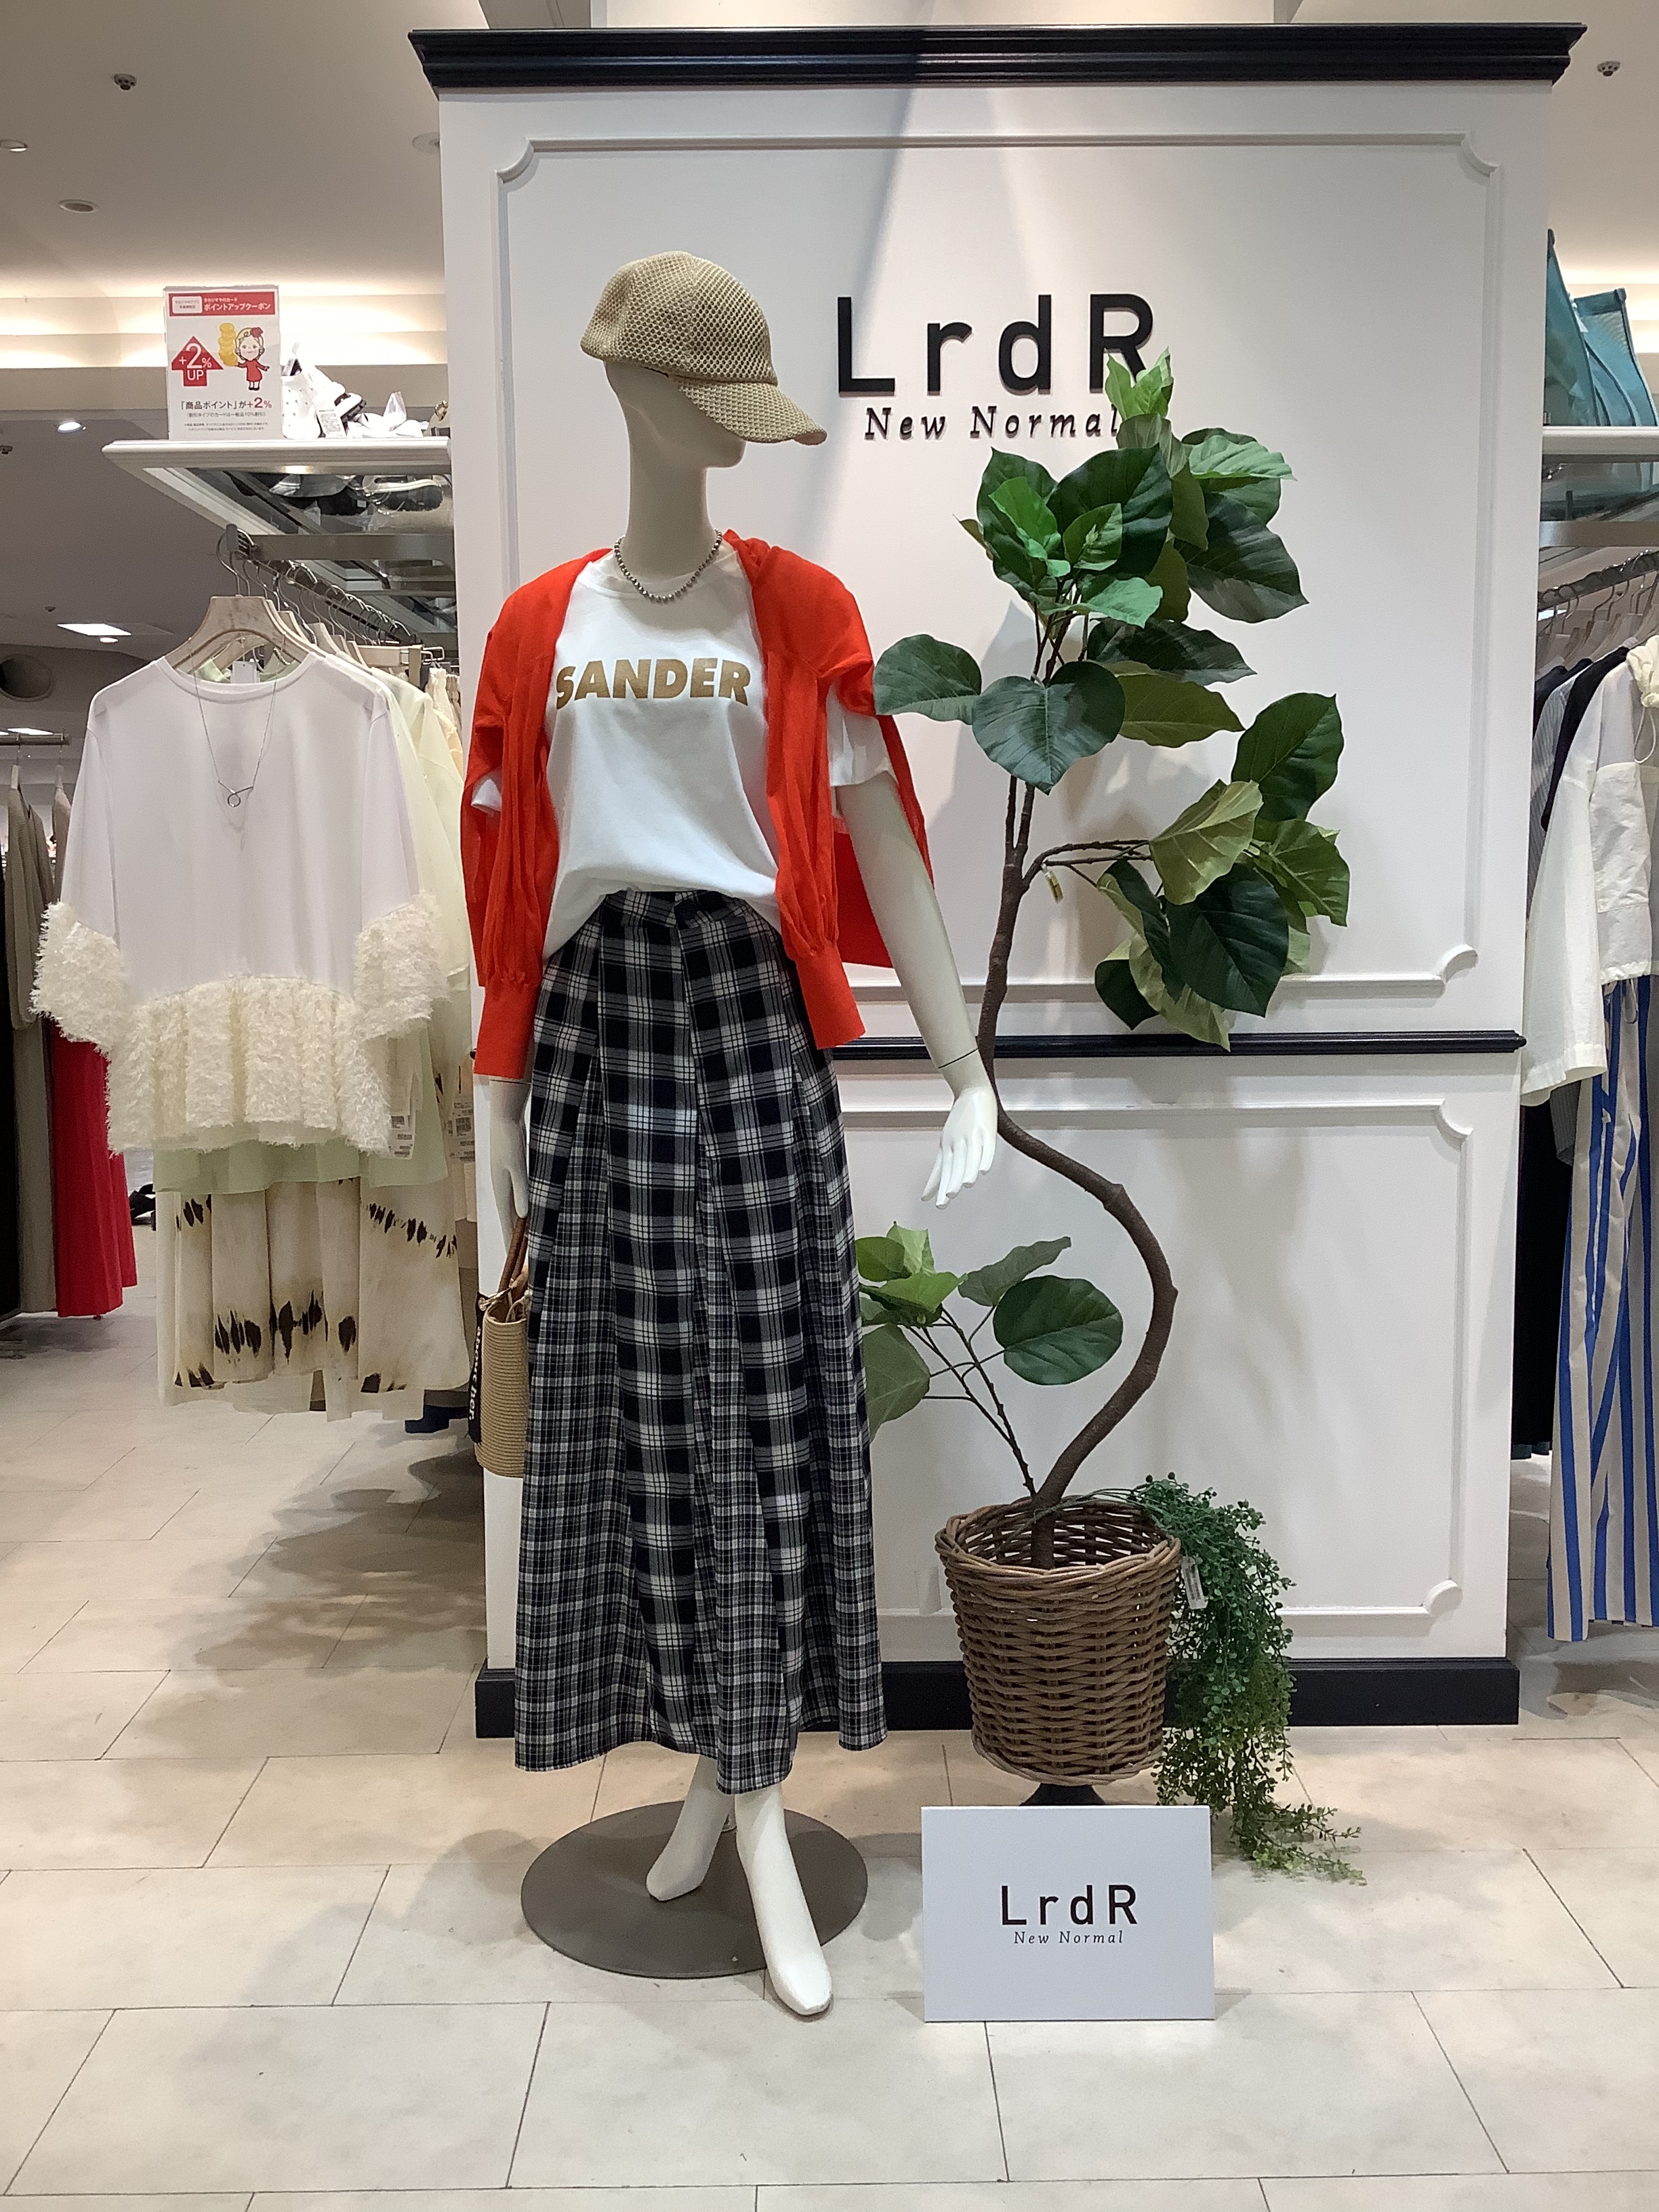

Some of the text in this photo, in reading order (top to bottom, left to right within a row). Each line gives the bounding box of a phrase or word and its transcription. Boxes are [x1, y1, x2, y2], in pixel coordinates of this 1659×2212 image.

[204, 302, 271, 311] ポイントアップクーポン
[837, 293, 1153, 397] LrdR
[187, 369, 204, 381] UP
[865, 405, 1119, 441] New Normal
[556, 657, 751, 710] SANDER
[1002, 1885, 1138, 1925] LrdR
[1014, 1930, 1123, 1944] New Normal
